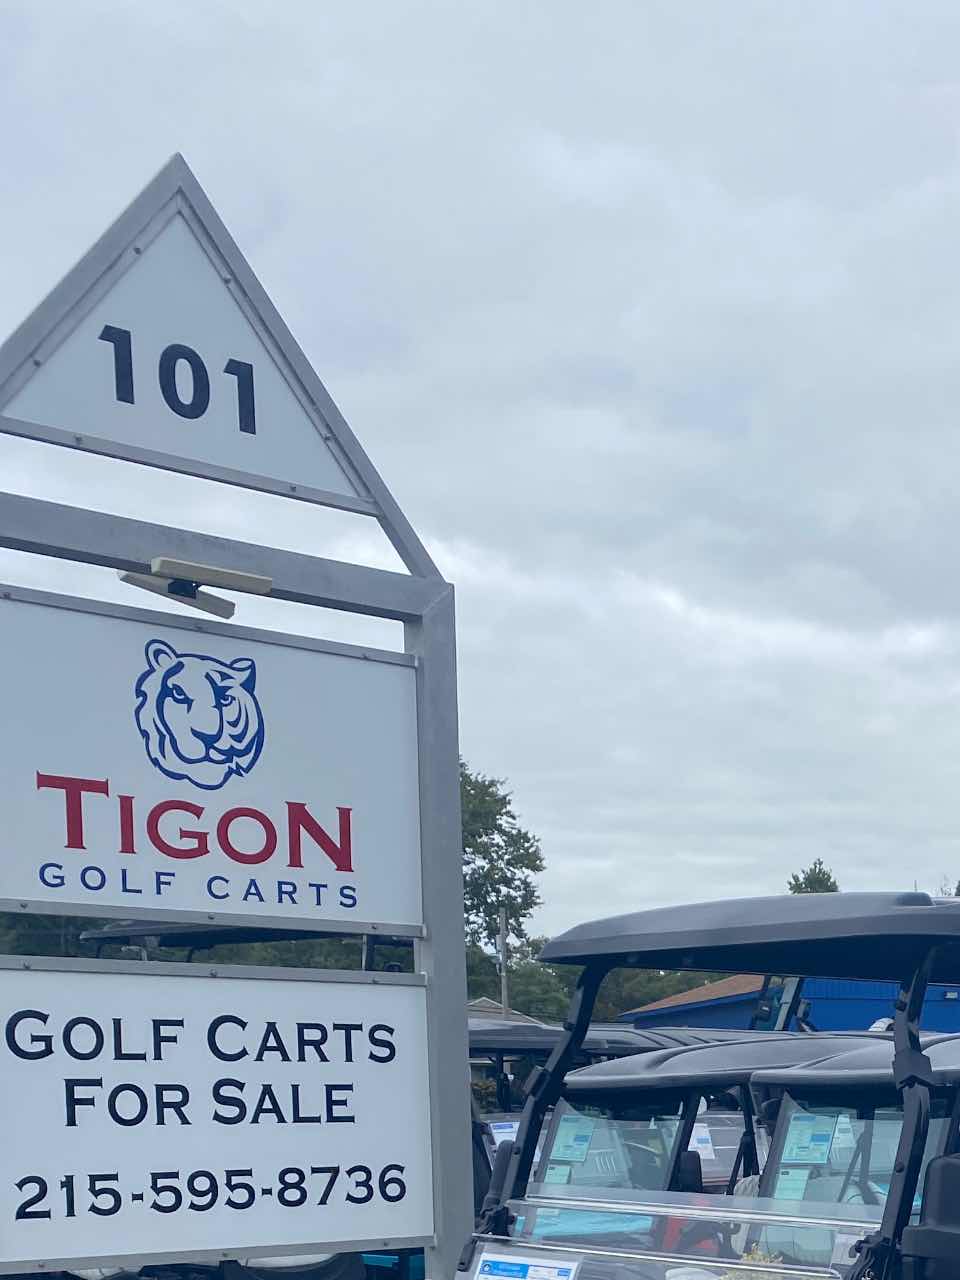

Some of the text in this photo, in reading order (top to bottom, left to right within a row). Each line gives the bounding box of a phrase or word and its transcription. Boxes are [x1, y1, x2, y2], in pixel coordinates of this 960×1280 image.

[98, 325, 256, 435] 101
[36, 770, 354, 873] TIGON
[38, 862, 358, 908] GOLF CARTS
[14, 1163, 407, 1220] 215-595-8736
